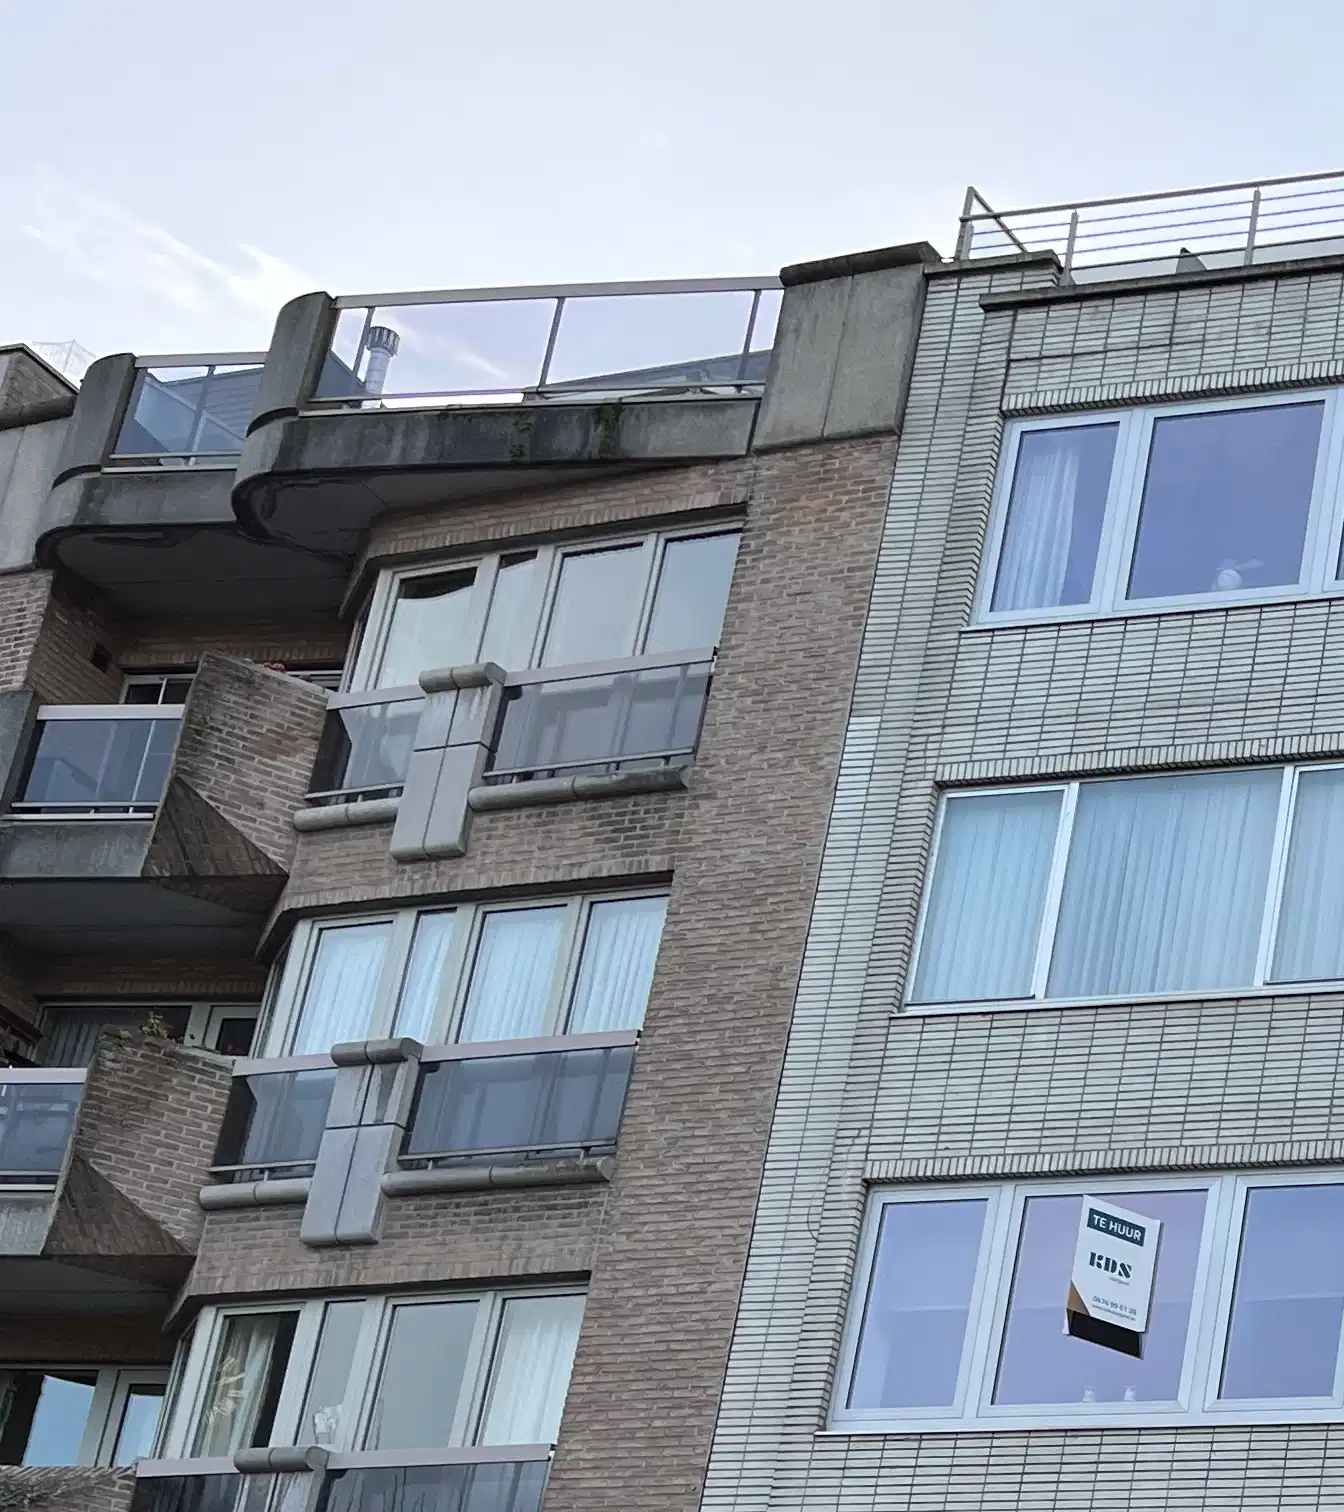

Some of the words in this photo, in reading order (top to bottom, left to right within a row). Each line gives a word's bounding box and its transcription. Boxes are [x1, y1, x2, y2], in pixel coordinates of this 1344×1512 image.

[1092, 1213, 1107, 1229] TE
[1108, 1220, 1142, 1241] HUUR
[1088, 1251, 1133, 1279] KDS
